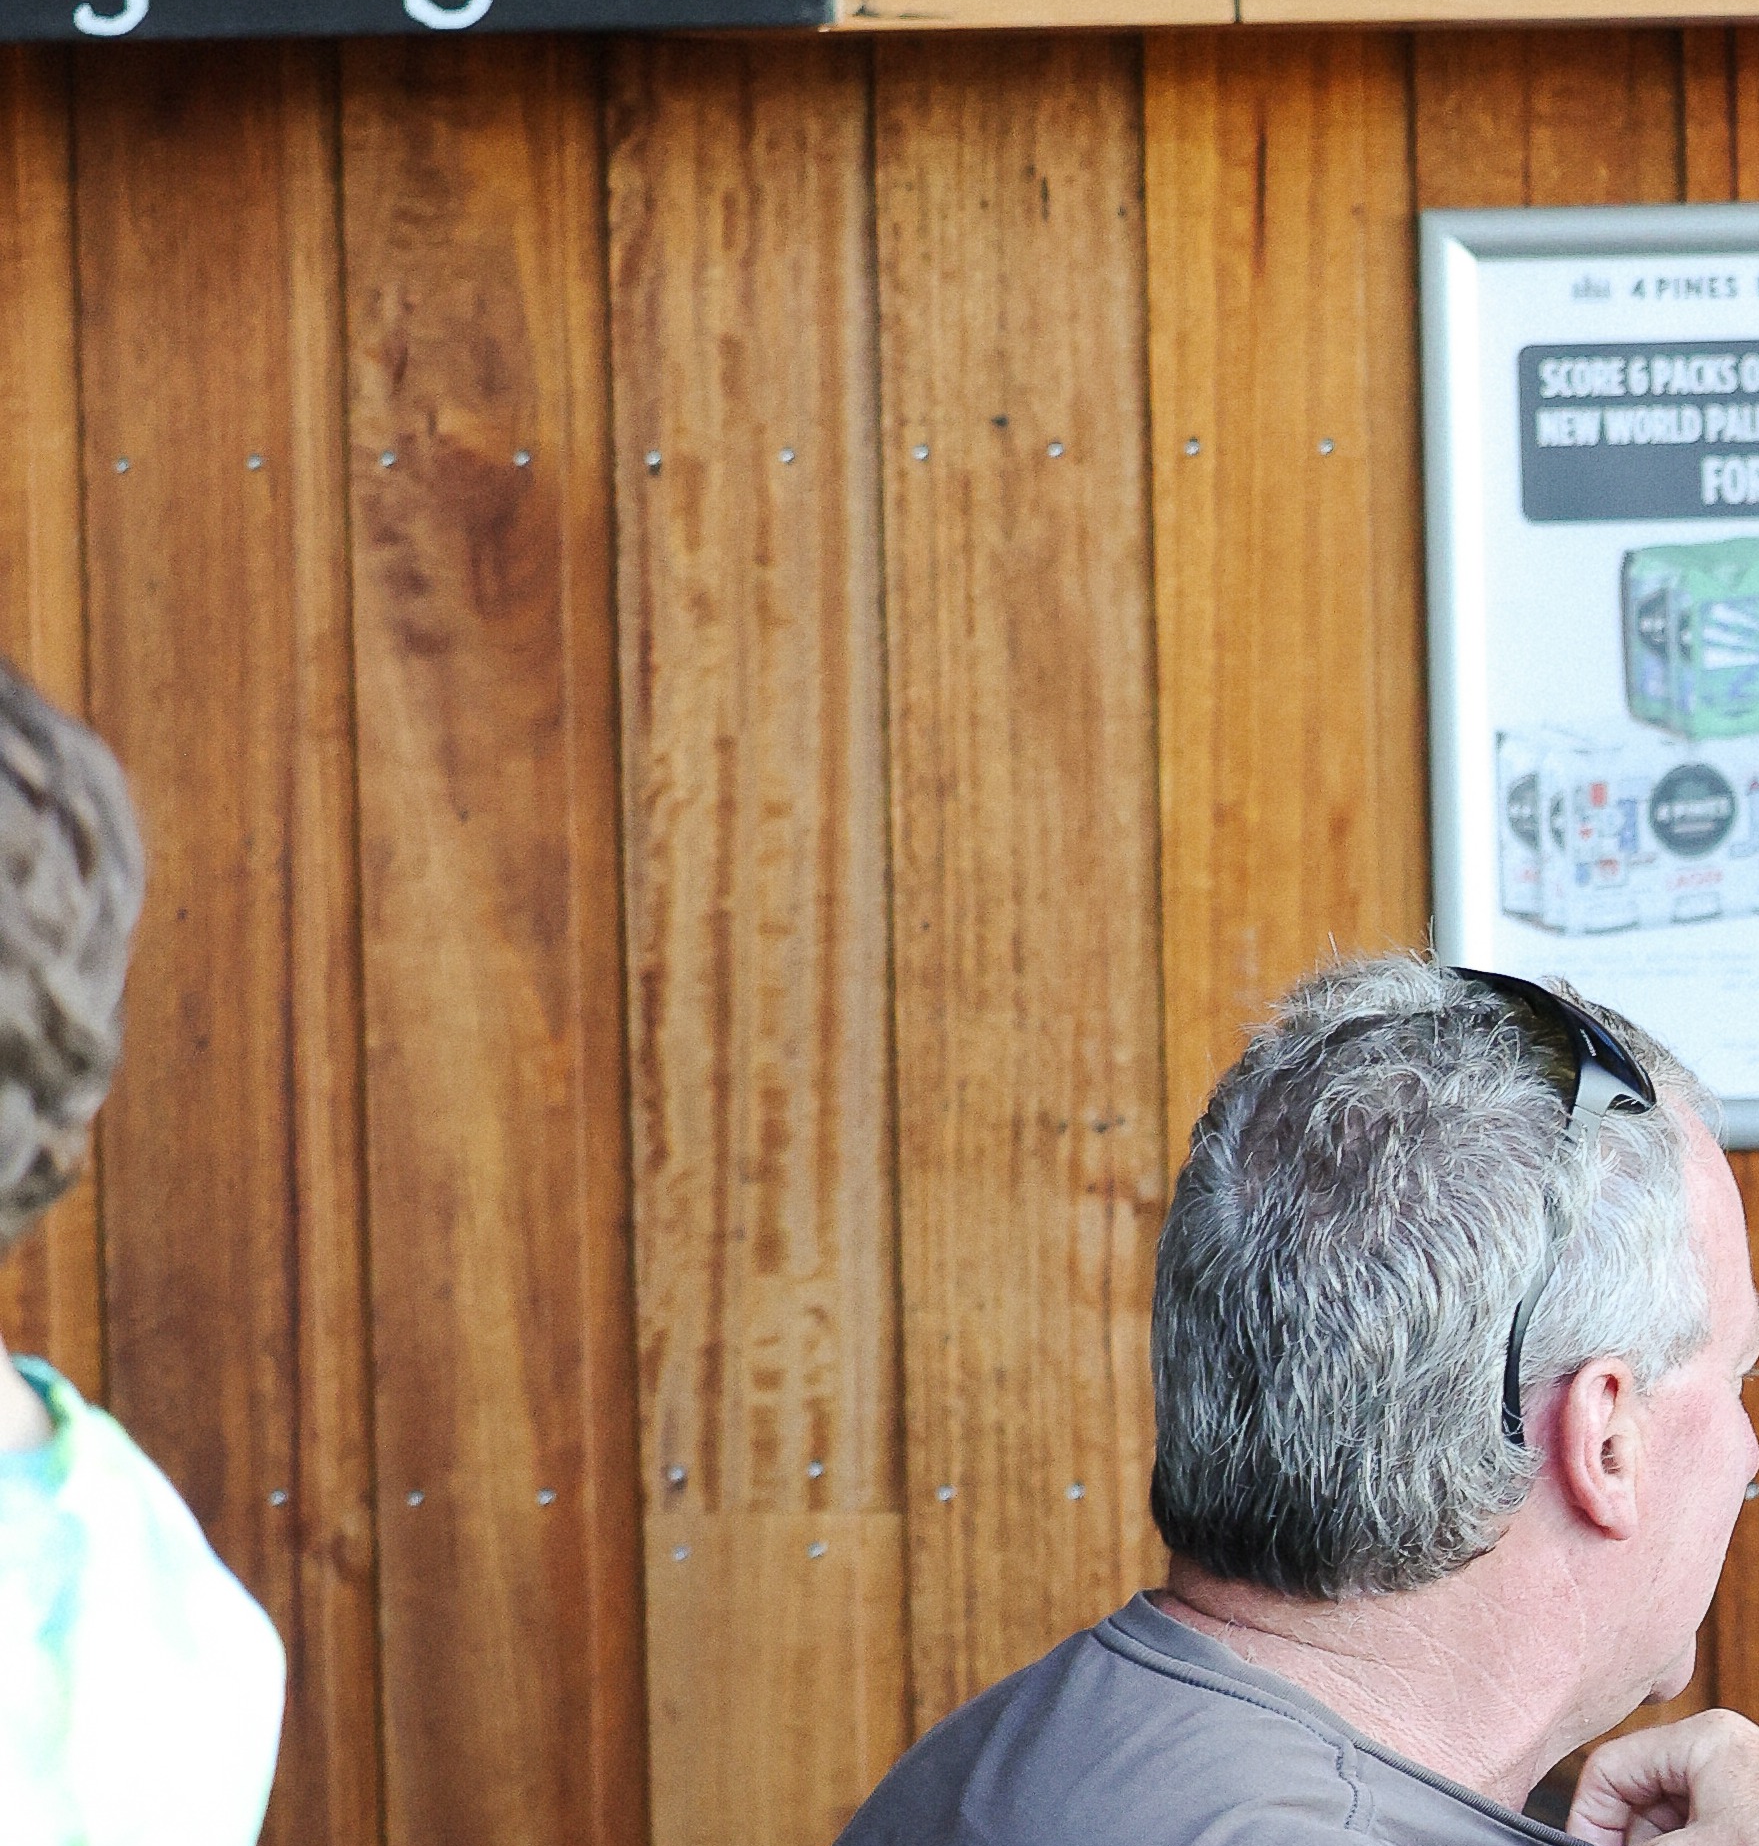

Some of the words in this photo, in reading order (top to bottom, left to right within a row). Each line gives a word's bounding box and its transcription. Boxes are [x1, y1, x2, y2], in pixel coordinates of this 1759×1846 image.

[1629, 278, 1647, 300] 4
[1656, 275, 1739, 300] PINES
[1539, 355, 1627, 399] SCORE
[1629, 354, 1649, 397] 6
[1650, 353, 1738, 396] PACKS
[1536, 405, 1600, 446] NEW
[1605, 404, 1702, 445] WORLD
